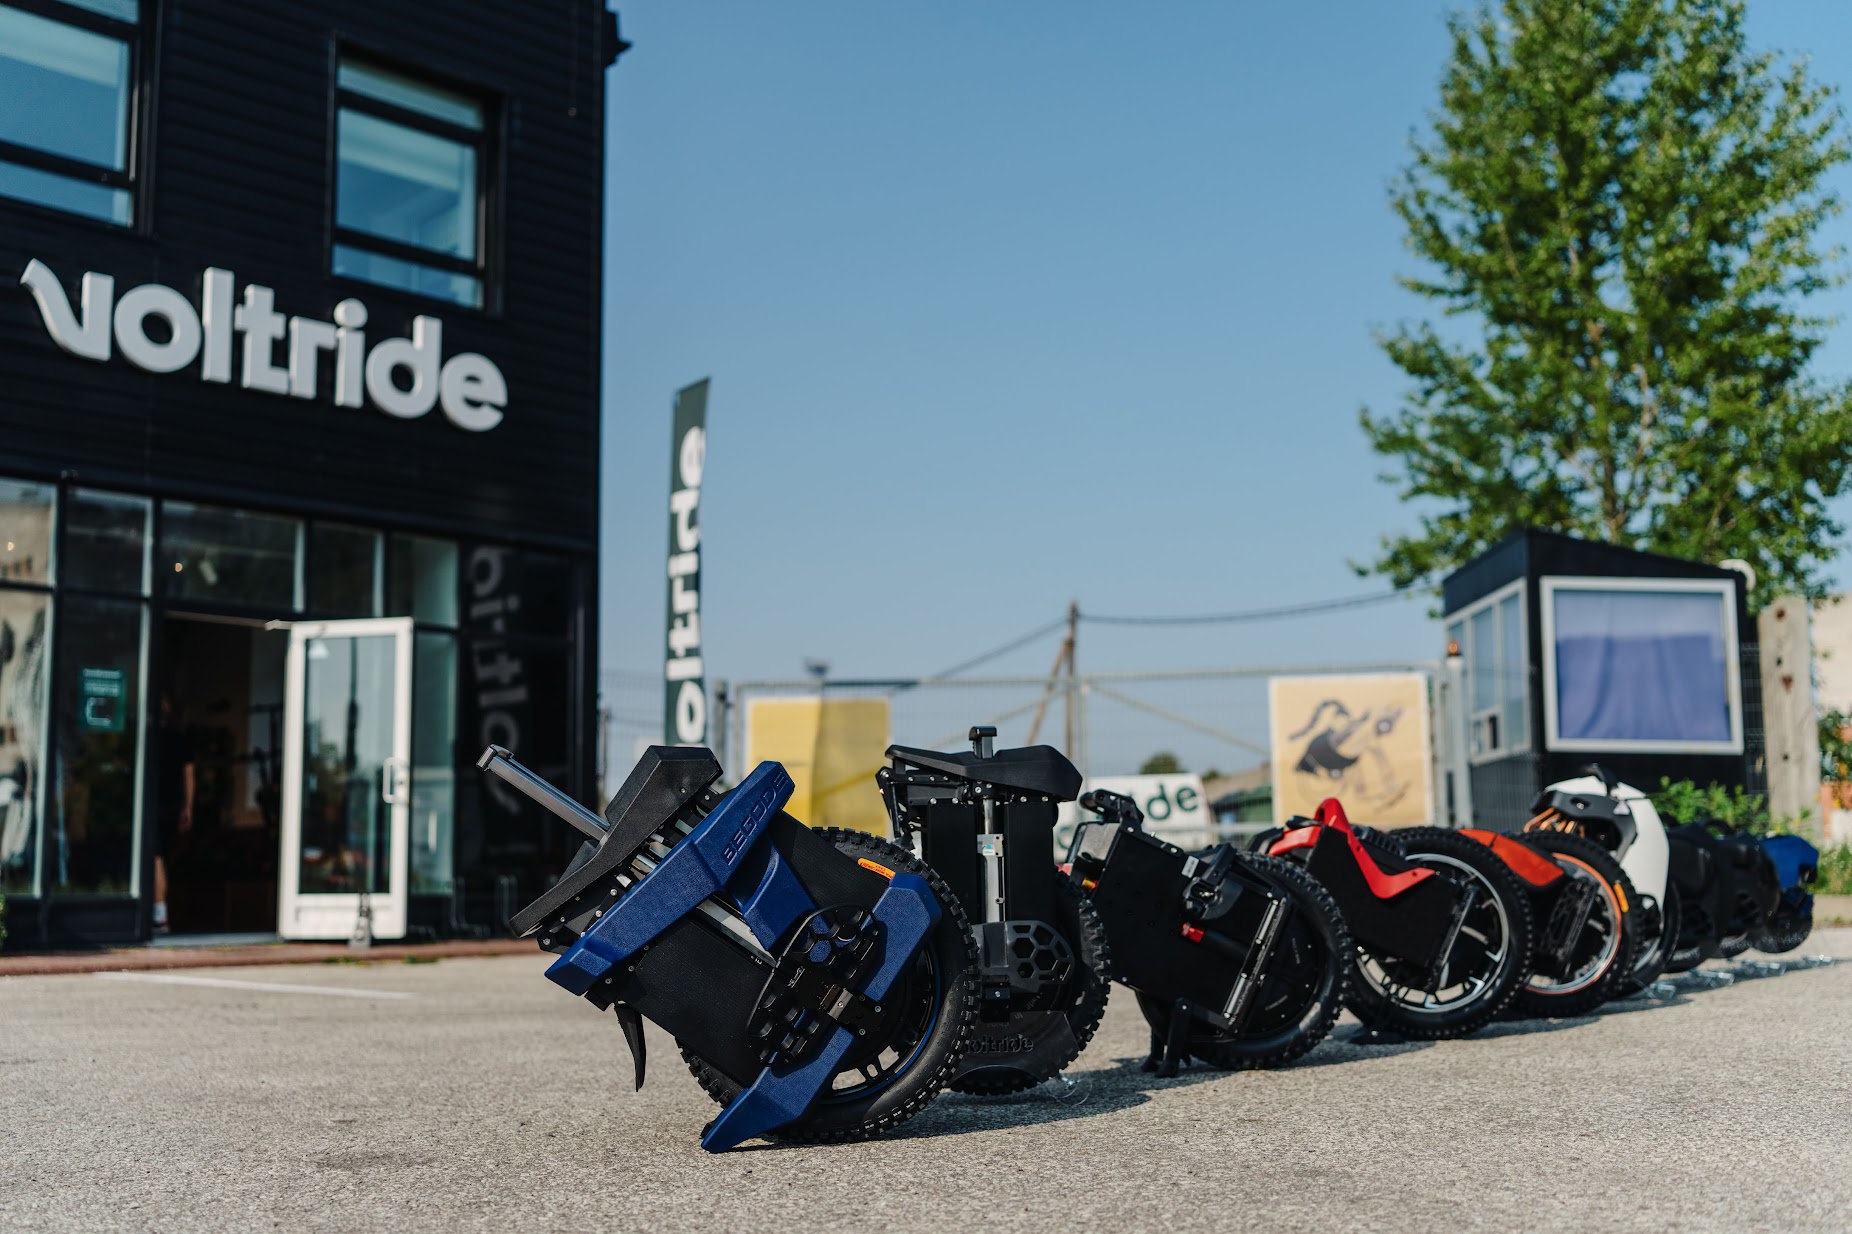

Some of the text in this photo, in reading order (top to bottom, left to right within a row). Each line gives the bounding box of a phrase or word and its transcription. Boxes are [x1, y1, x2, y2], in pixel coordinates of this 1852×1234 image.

[20, 258, 508, 433] voltride
[666, 425, 707, 747] oltride
[722, 770, 790, 868] BEGODE
